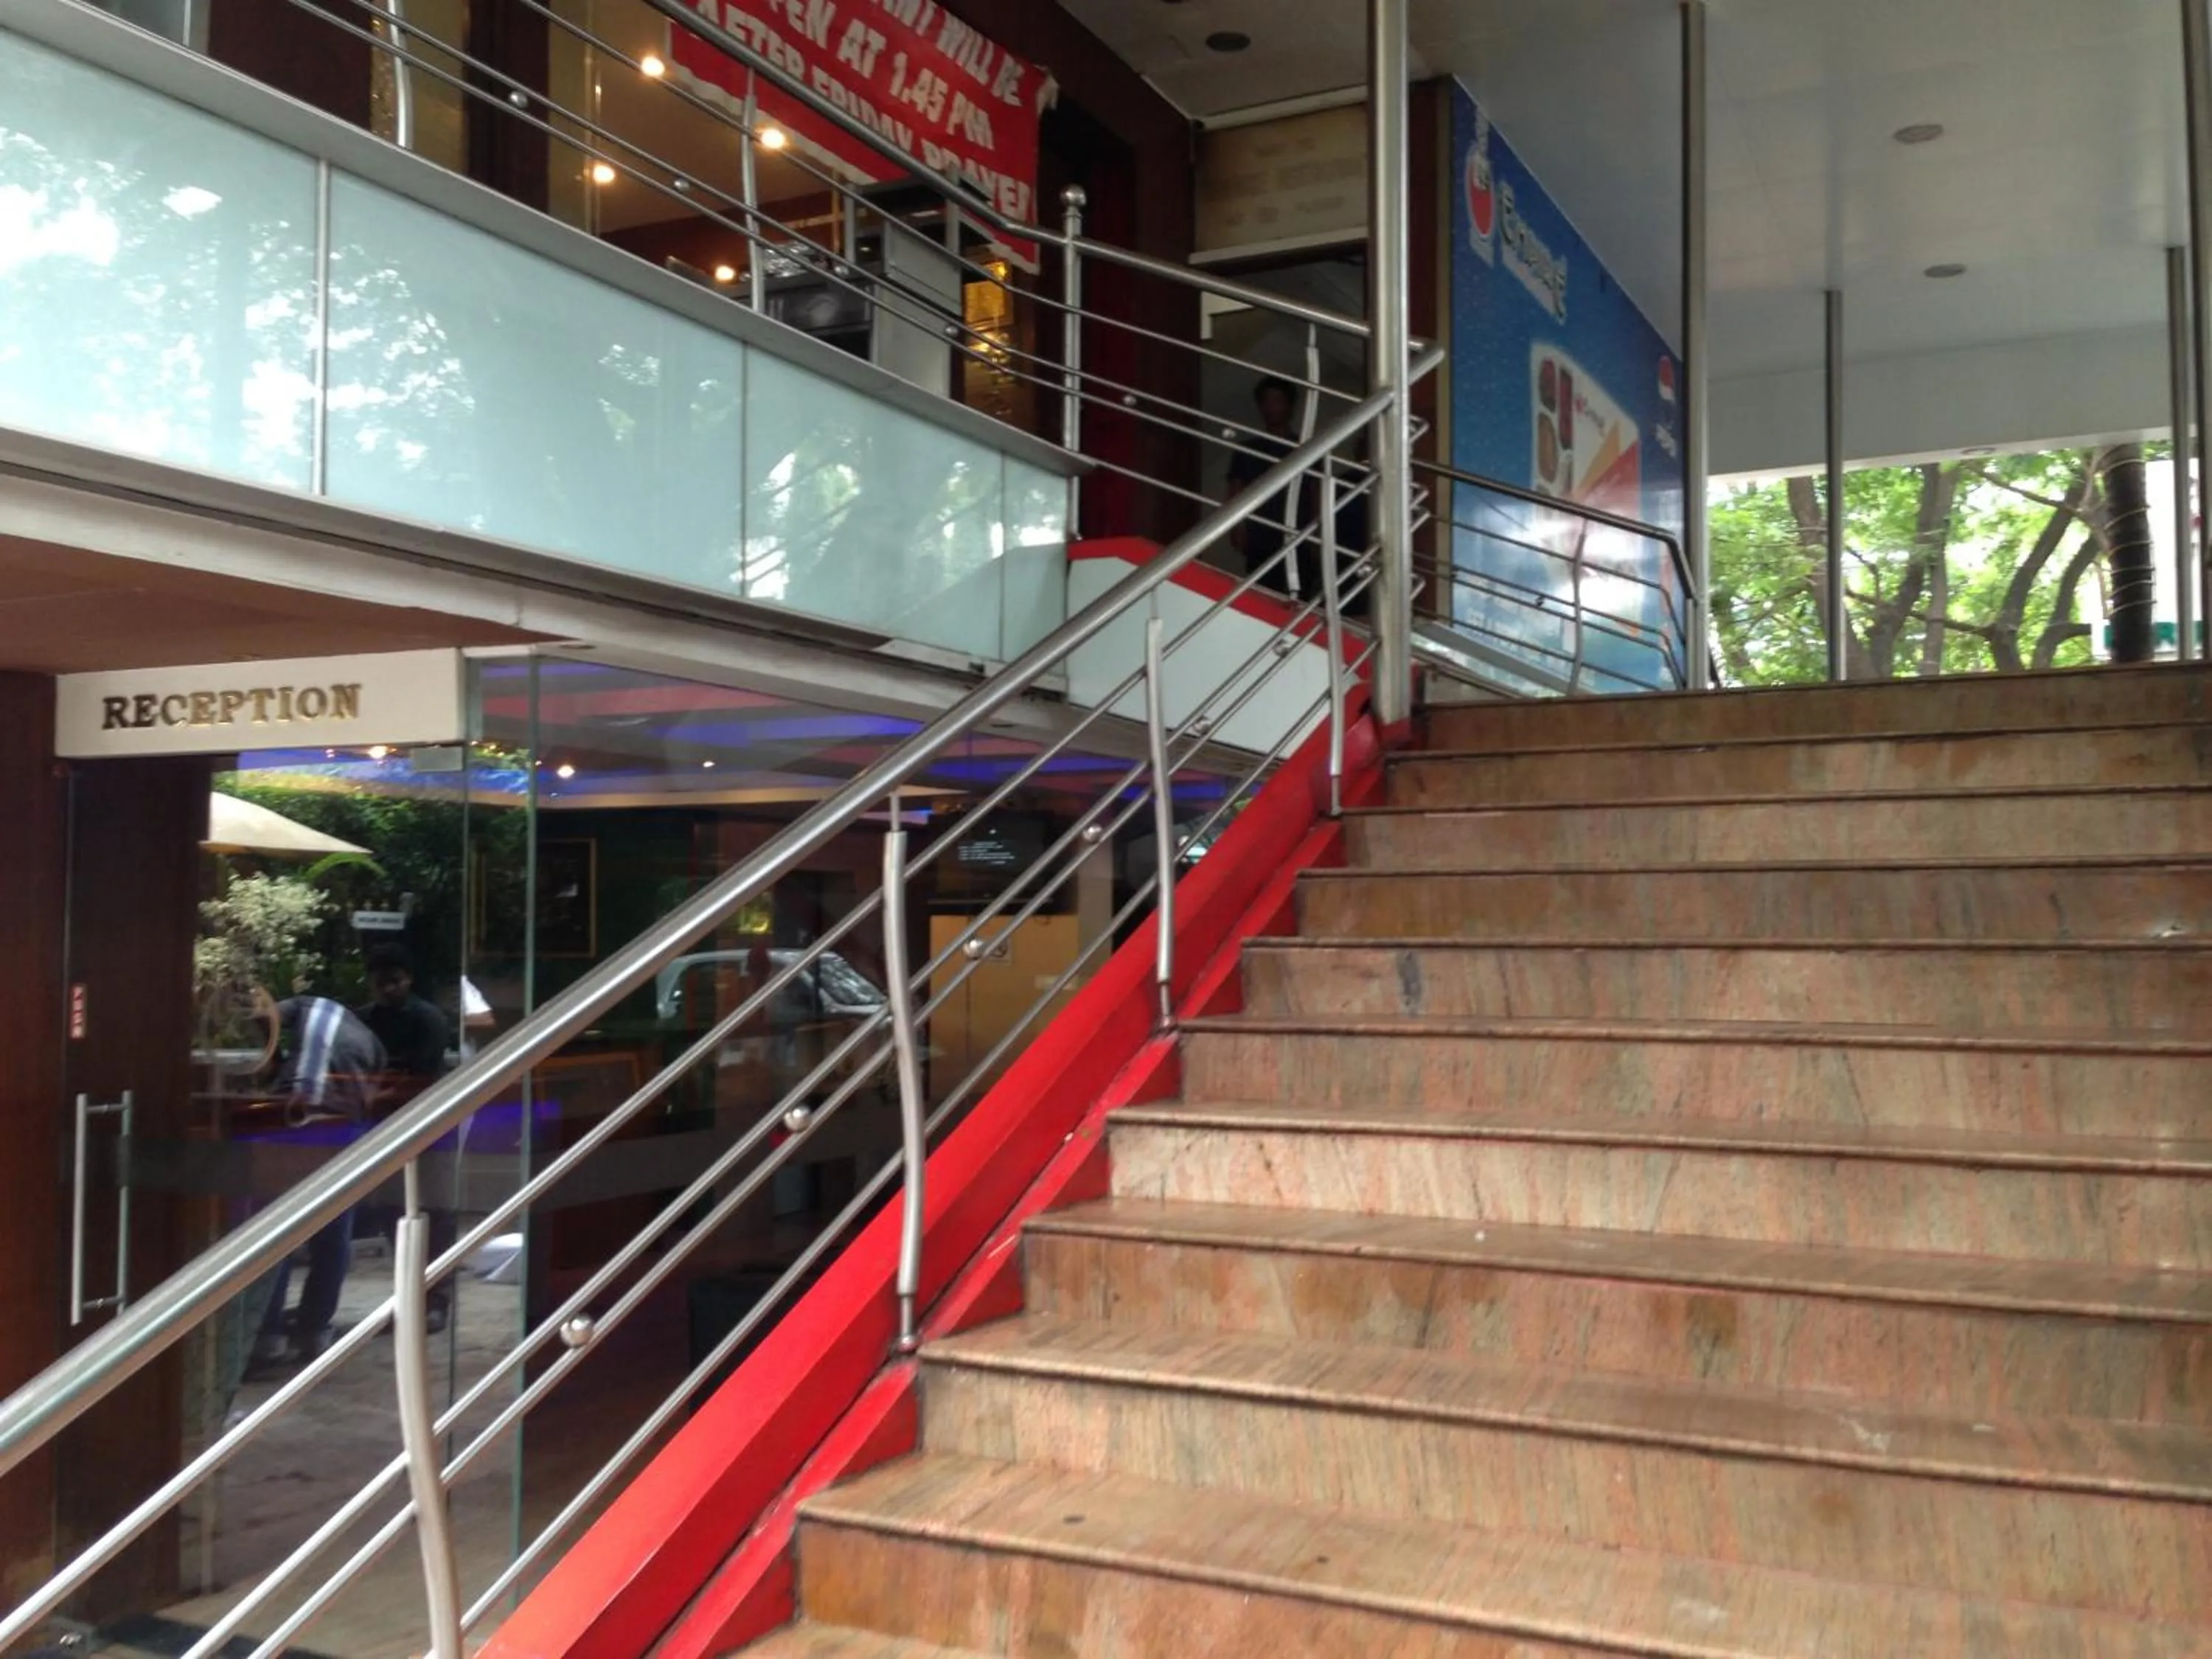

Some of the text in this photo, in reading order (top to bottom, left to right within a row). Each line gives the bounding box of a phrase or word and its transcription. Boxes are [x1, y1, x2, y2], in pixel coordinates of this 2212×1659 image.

[837, 18, 887, 79] AT
[888, 52, 948, 123] 1.45
[946, 91, 995, 150] PM
[936, 10, 994, 86] WILL
[991, 53, 1025, 107] BE
[102, 683, 362, 730] RECEPTION
